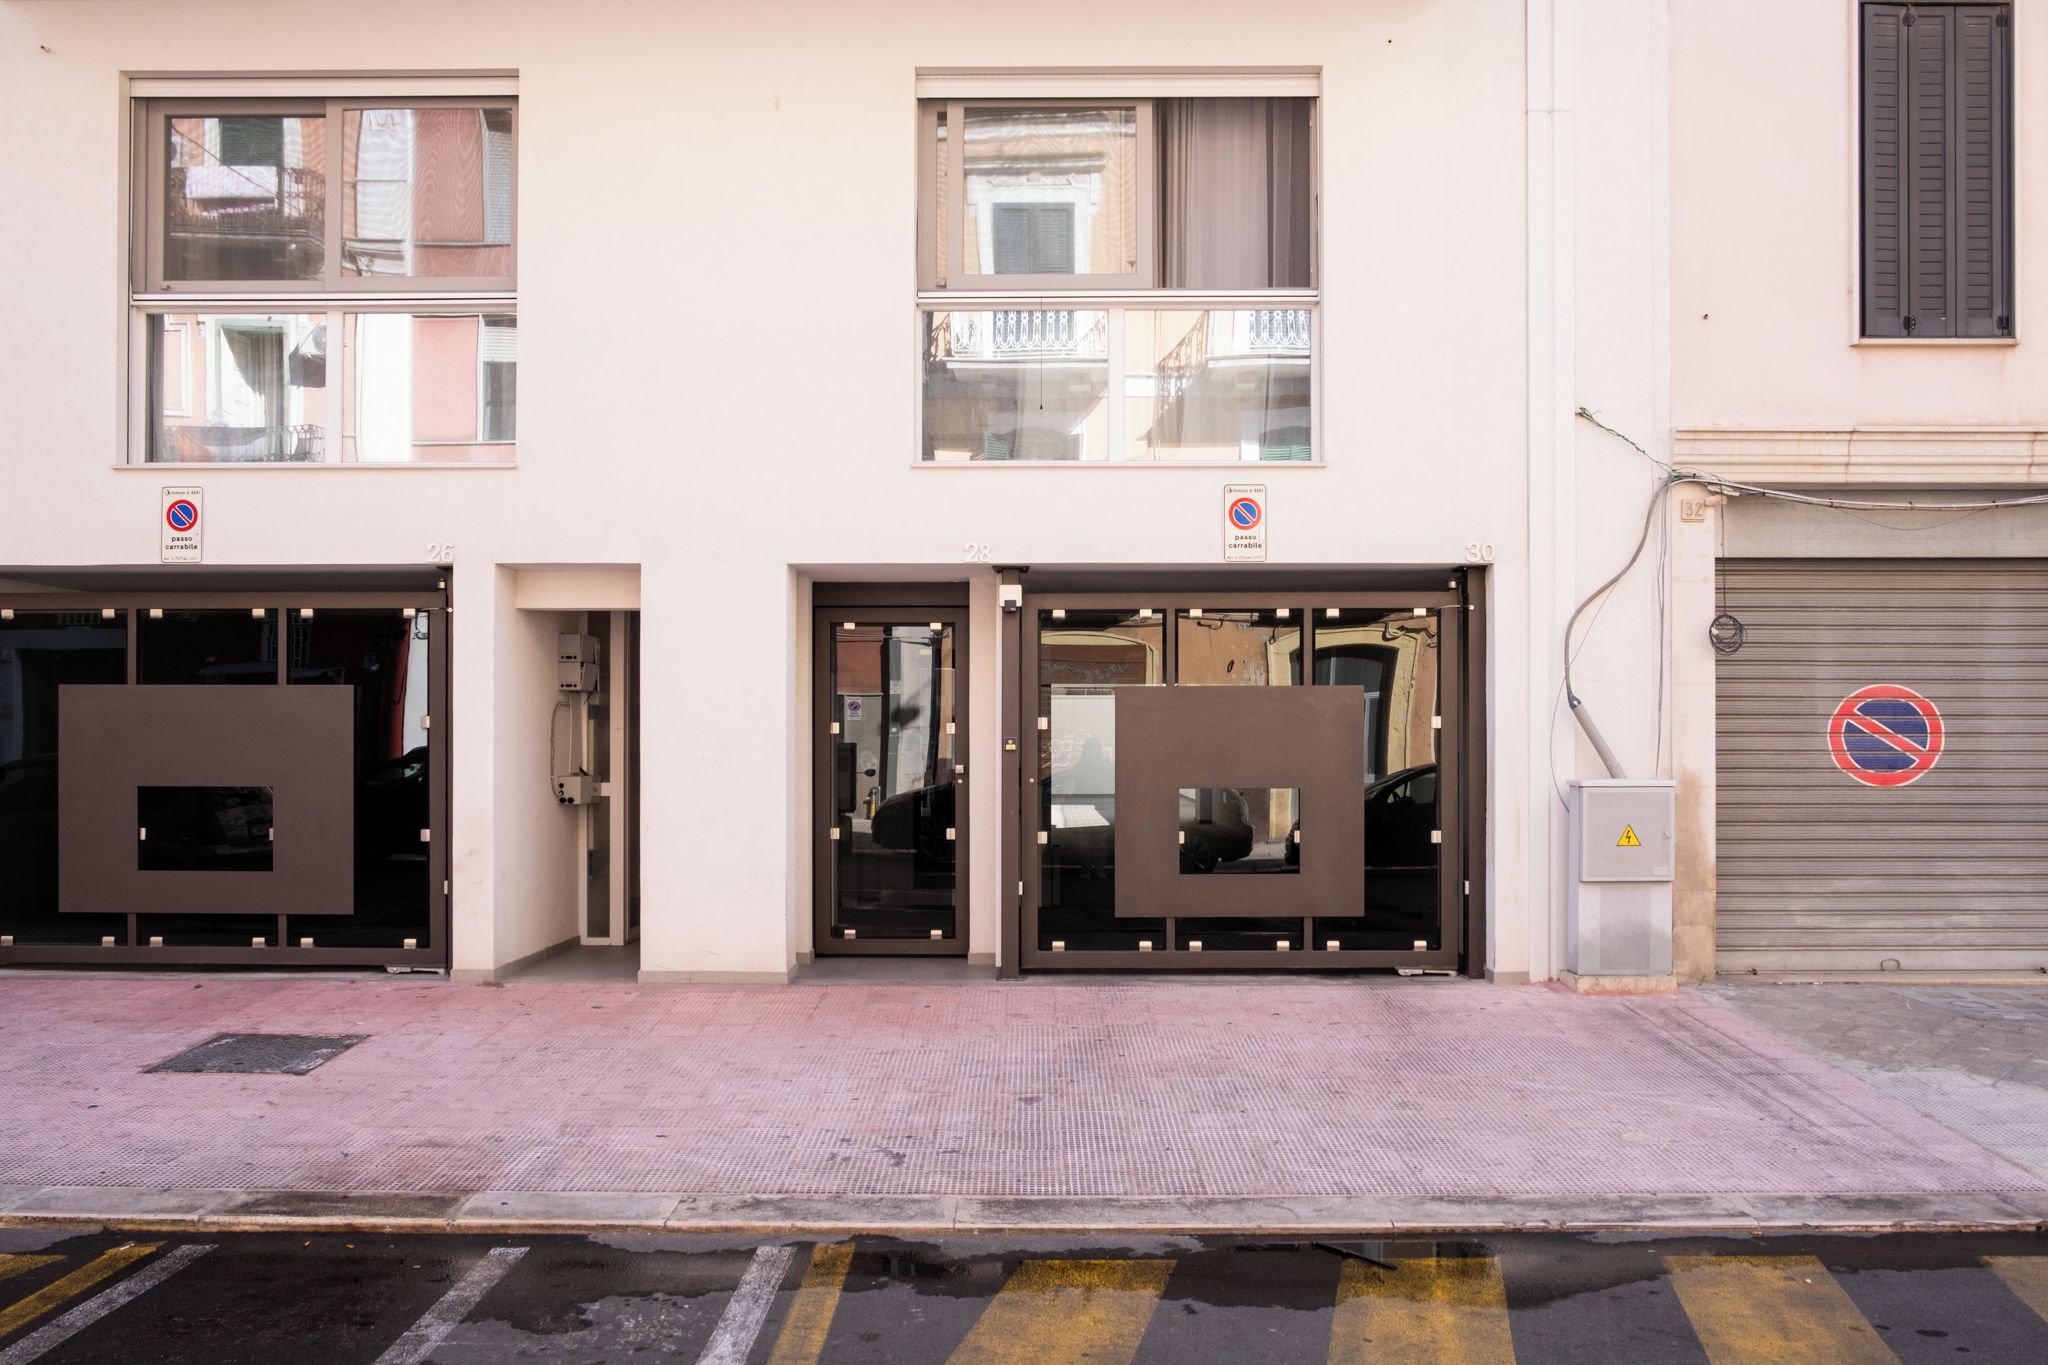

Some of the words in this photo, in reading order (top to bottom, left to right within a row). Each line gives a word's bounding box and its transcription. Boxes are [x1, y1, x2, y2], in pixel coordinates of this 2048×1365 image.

[1685, 502, 1703, 516] 32
[426, 543, 454, 562] 26
[963, 542, 991, 562] 28
[1465, 542, 1494, 562] 30
